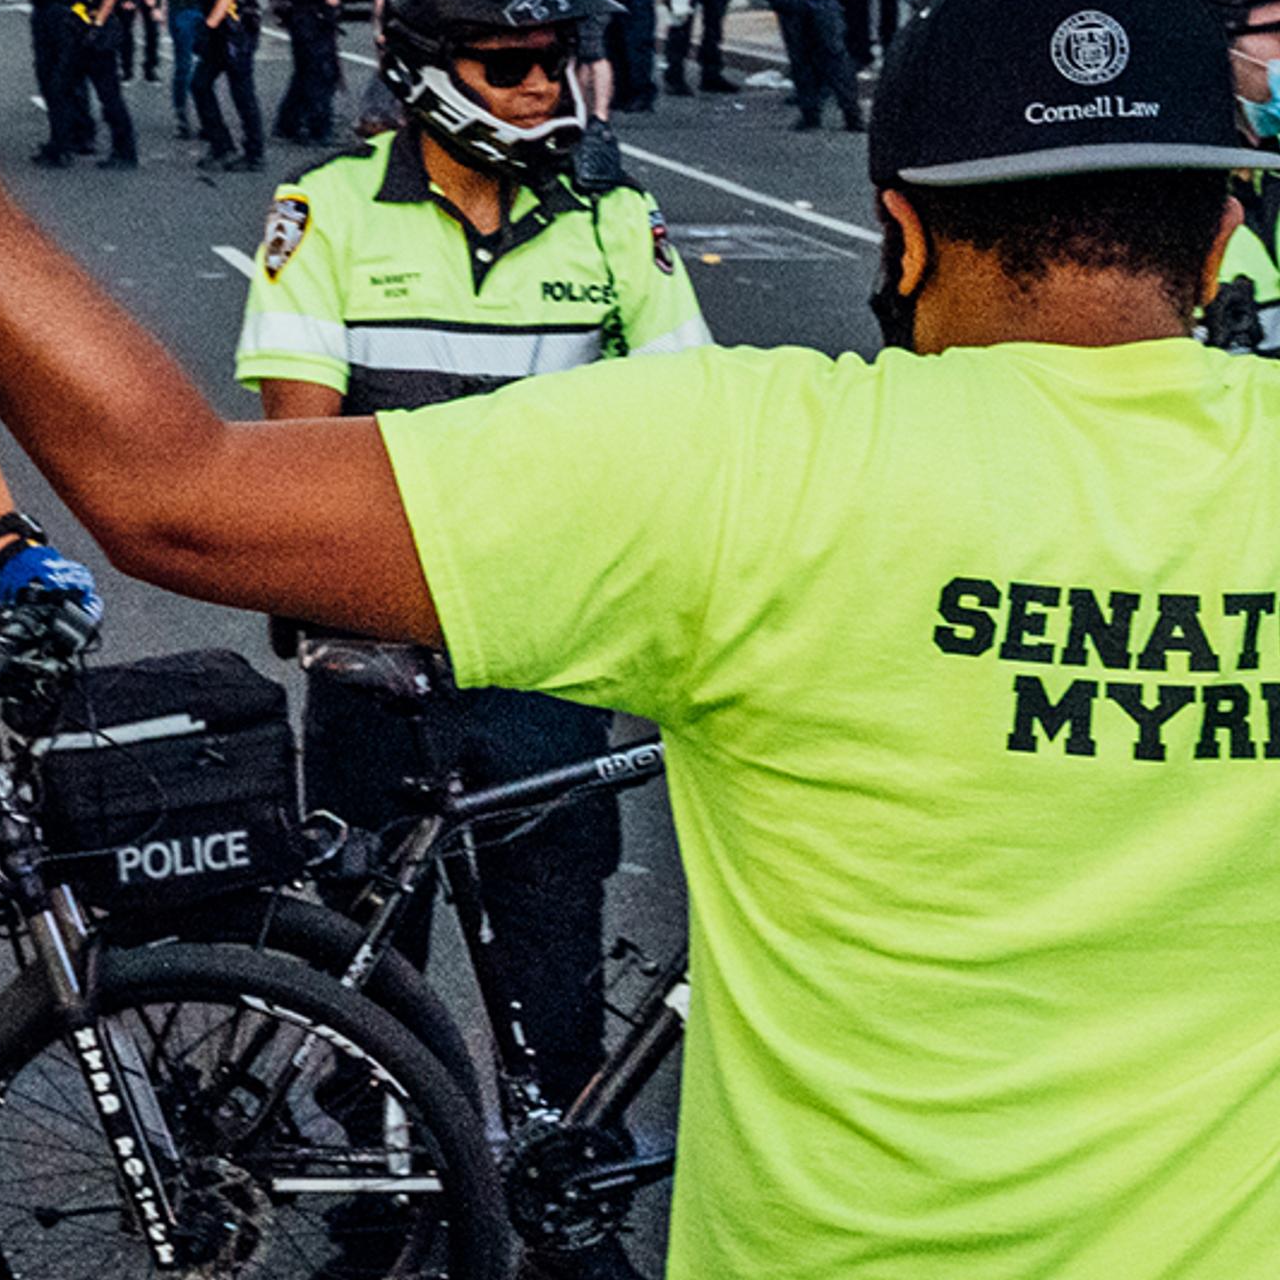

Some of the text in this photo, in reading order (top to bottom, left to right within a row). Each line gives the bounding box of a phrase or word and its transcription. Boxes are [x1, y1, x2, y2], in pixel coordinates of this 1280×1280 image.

[1024, 95, 1161, 125] Cornell Law
[541, 280, 618, 304] POLICE
[933, 576, 1280, 672] SENAT
[594, 742, 664, 781] PO
[116, 830, 251, 884] POLICE
